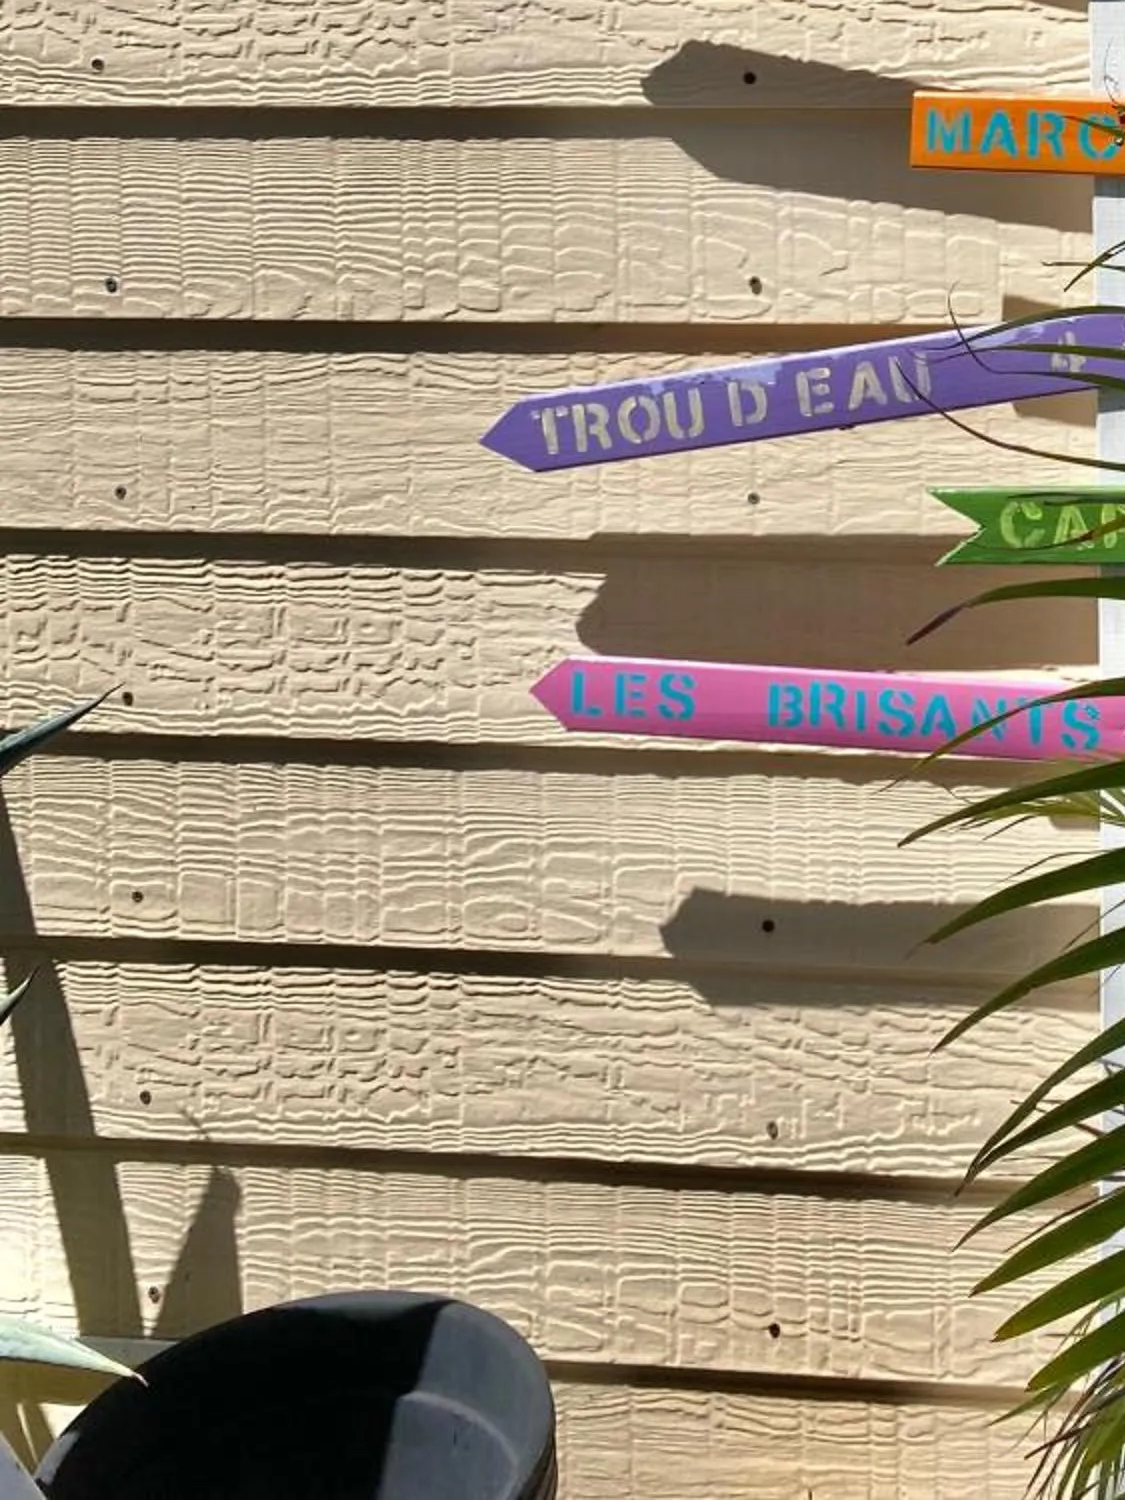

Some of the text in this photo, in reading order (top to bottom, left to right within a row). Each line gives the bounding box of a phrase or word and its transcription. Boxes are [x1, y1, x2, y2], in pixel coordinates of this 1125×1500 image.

[532, 387, 705, 455] TROU
[729, 380, 768, 427] D
[570, 671, 1100, 751] LES BRISANTS
